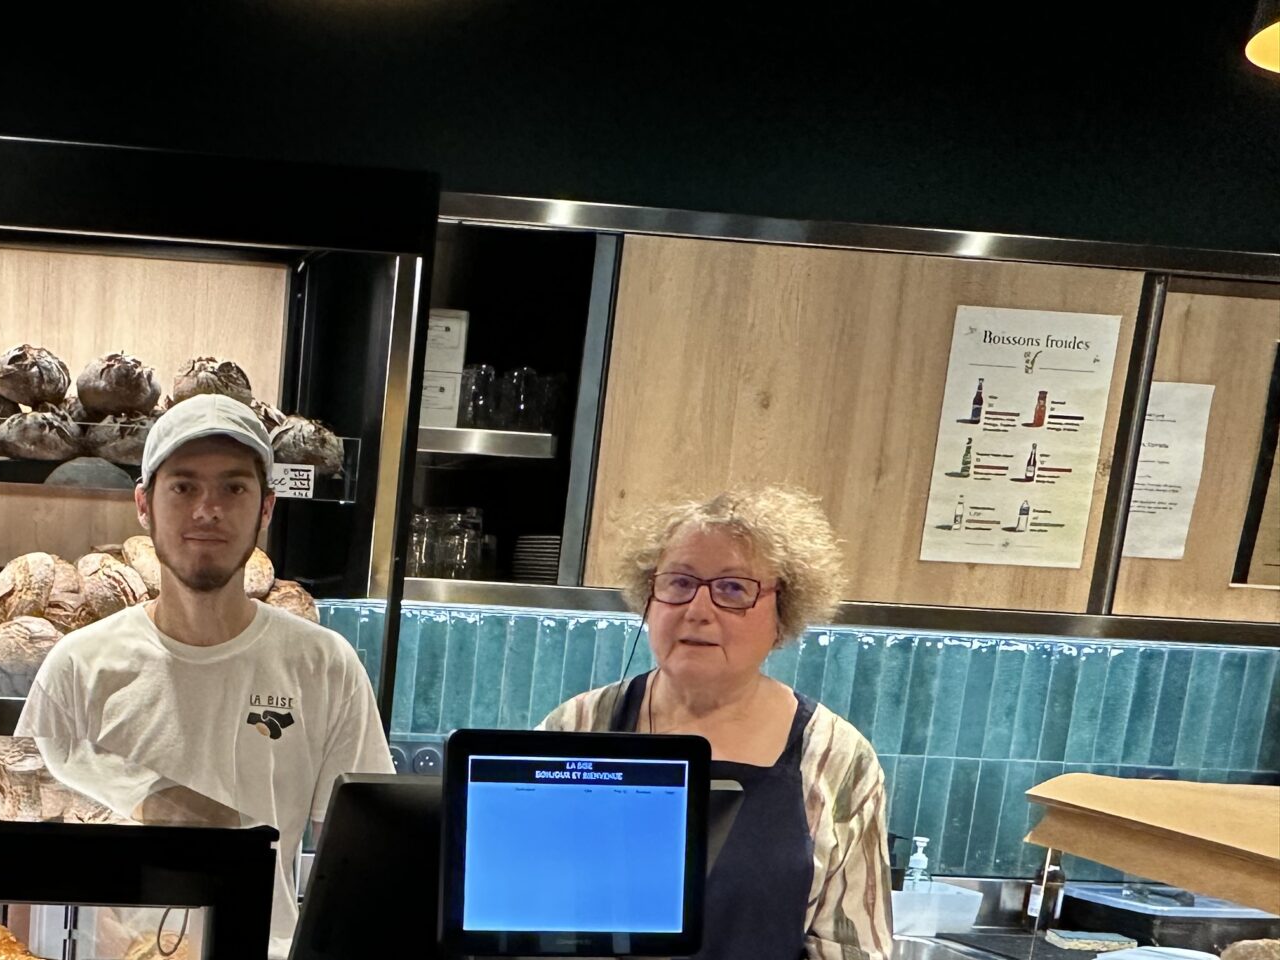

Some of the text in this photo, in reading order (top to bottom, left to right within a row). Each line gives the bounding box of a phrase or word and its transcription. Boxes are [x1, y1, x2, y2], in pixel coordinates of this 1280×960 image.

[982, 330, 1091, 351] Boissons froides
[249, 694, 261, 706] LA
